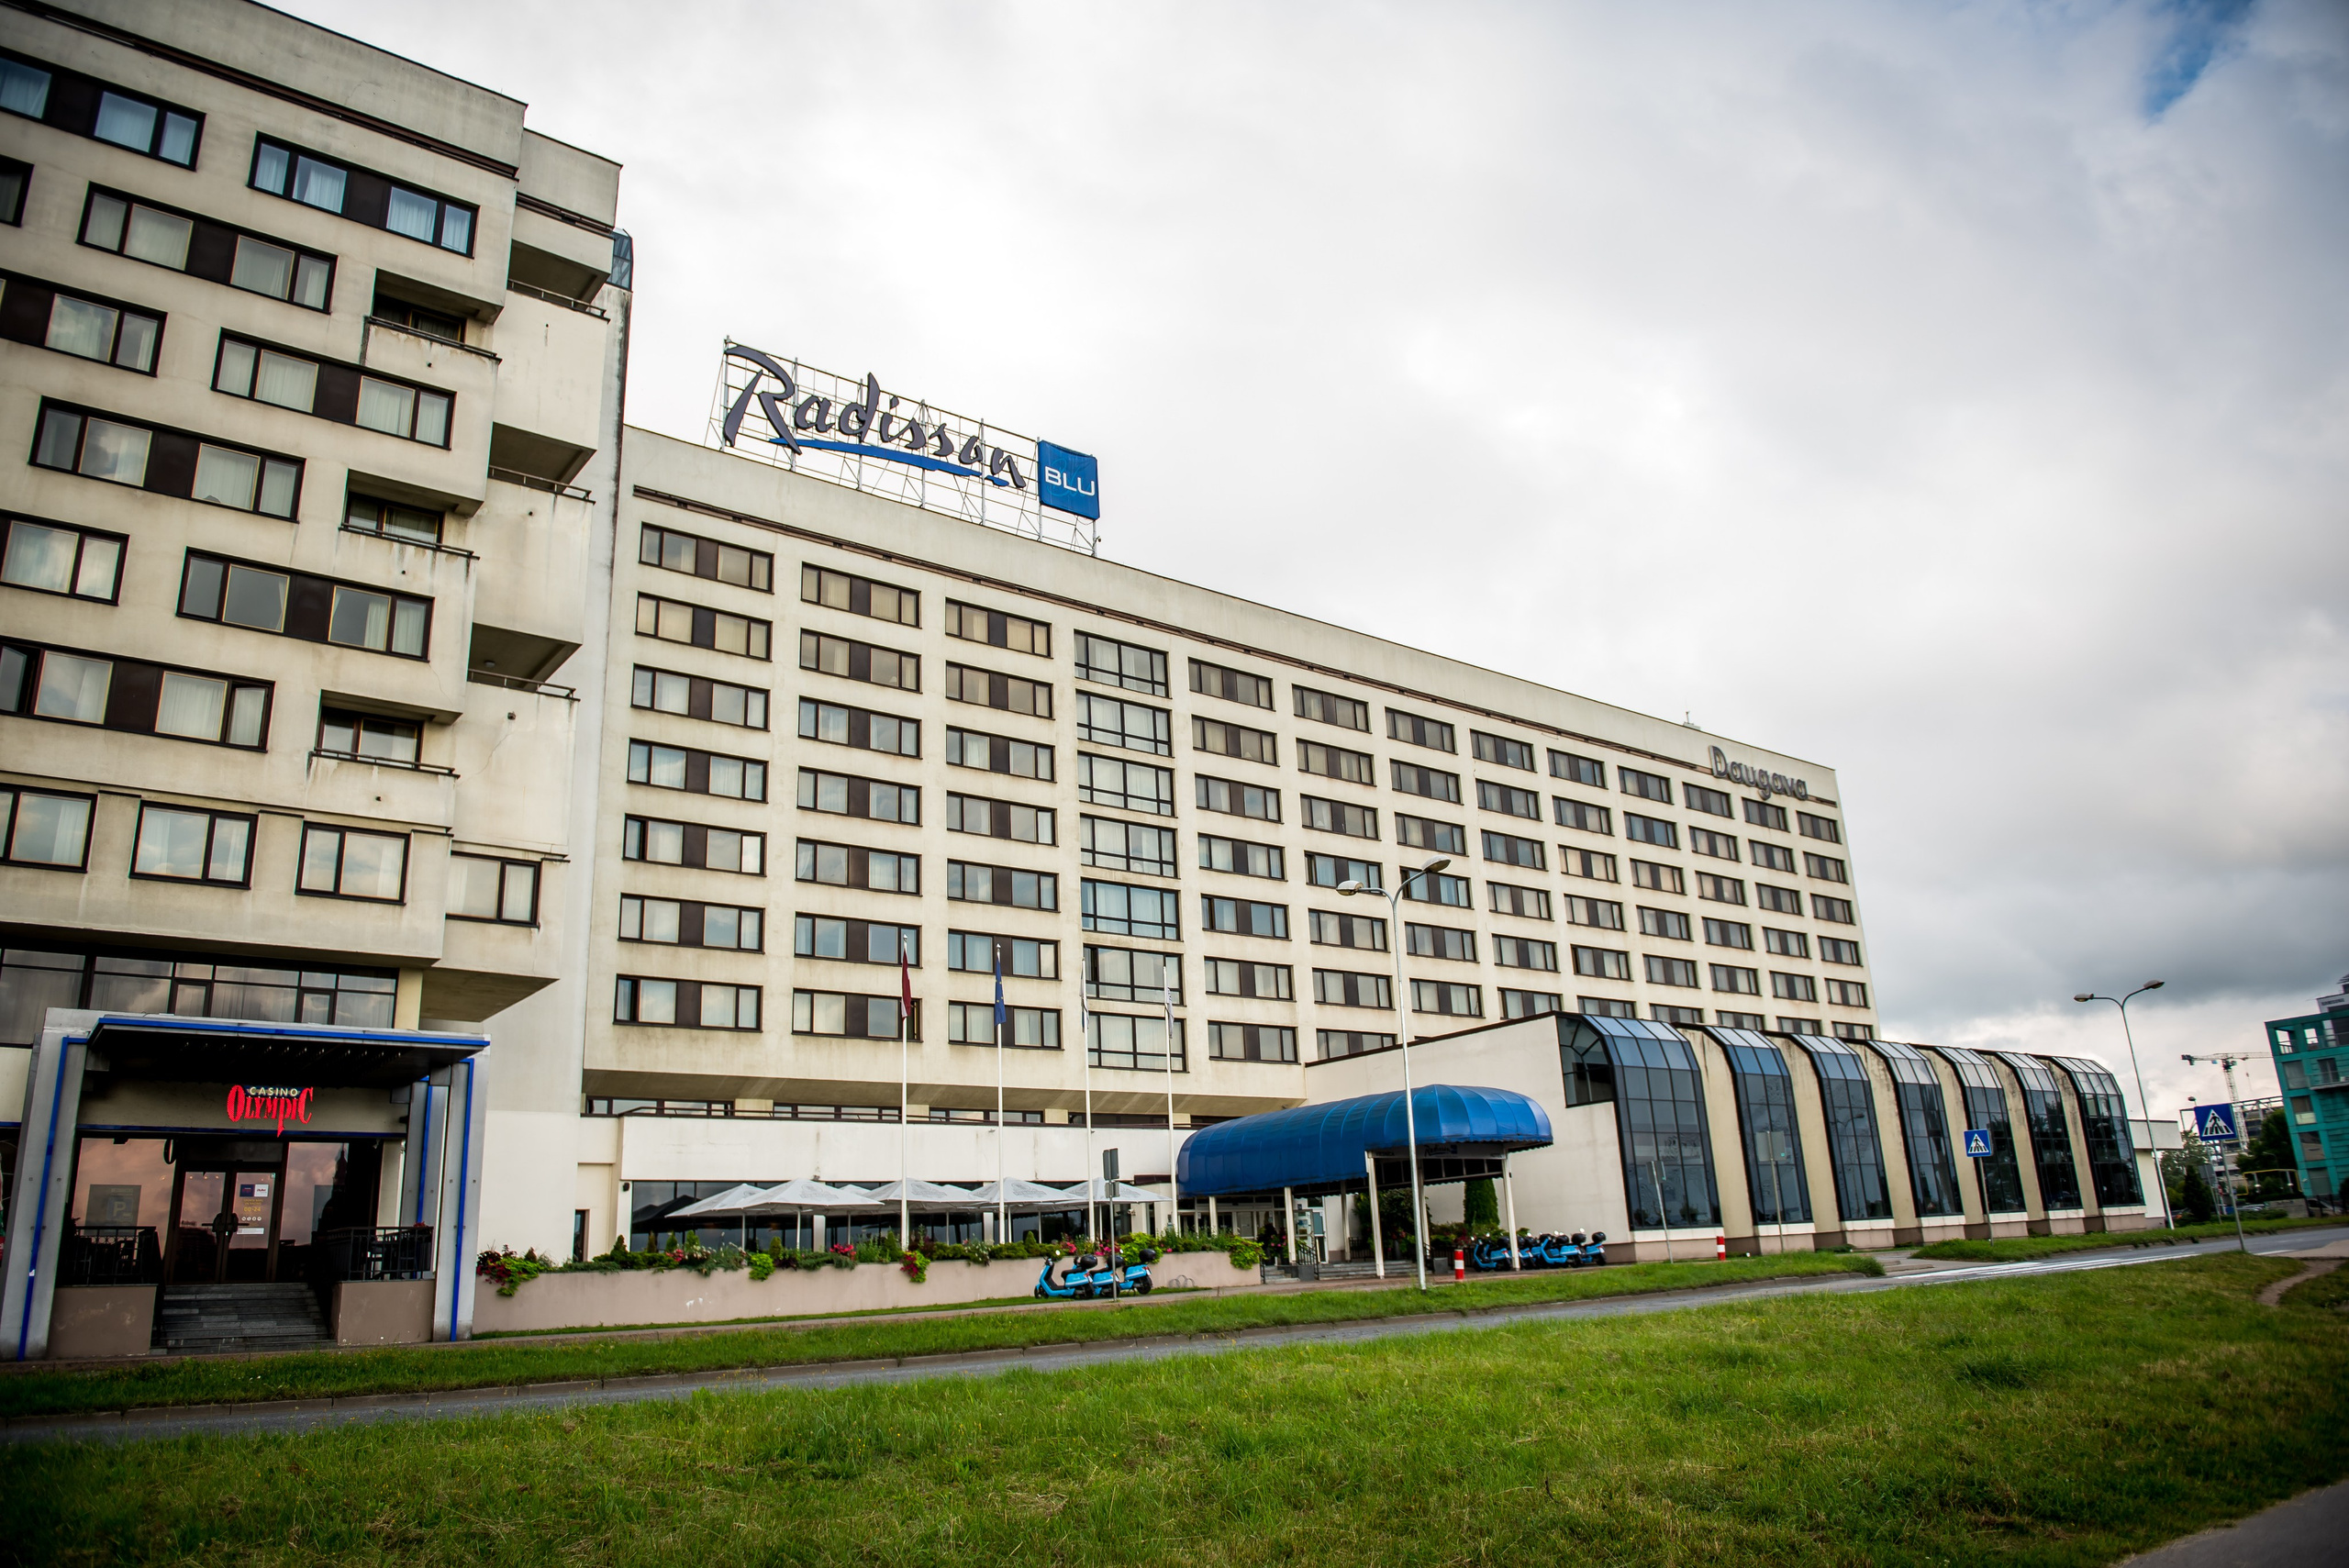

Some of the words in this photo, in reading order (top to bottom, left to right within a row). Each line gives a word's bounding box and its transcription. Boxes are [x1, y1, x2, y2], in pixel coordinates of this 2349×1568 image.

[723, 344, 1026, 488] Radisson
[1044, 465, 1096, 496] BLU
[1708, 745, 1809, 801] Daugava
[250, 1086, 298, 1096] CASINO
